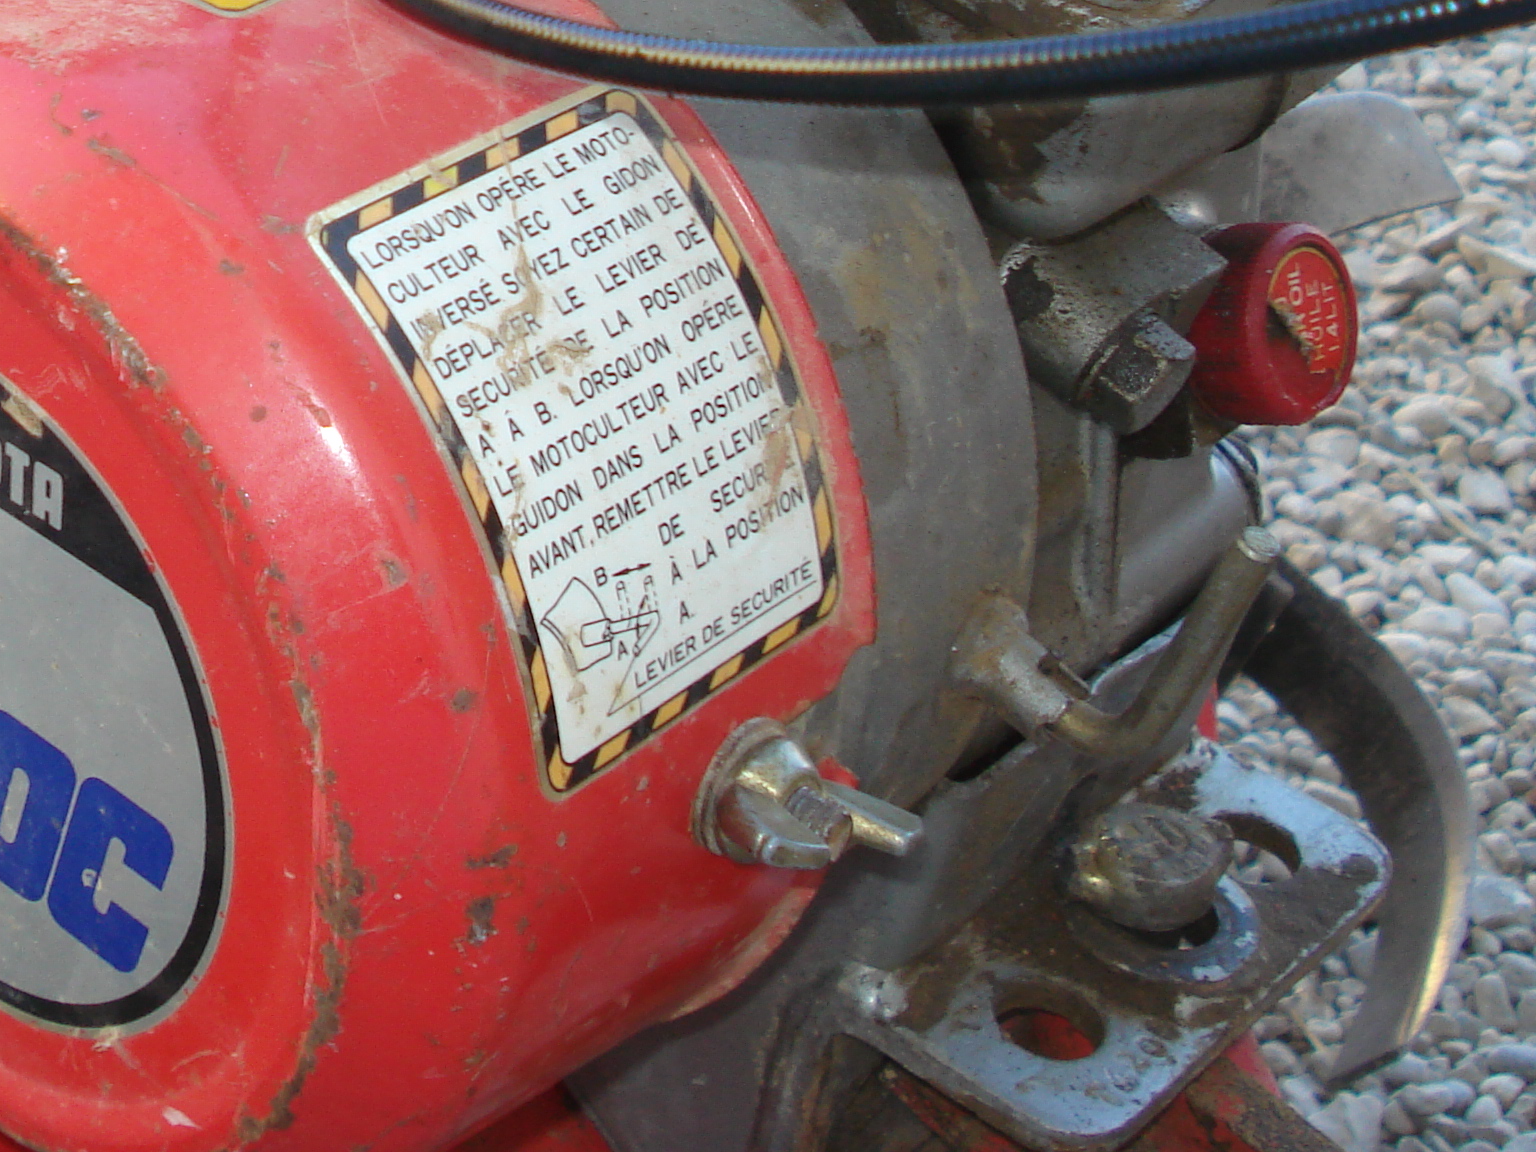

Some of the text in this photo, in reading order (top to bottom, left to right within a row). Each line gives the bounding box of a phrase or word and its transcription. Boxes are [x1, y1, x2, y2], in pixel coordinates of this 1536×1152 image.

[360, 127, 637, 270] LORSQU'ON OPÉRE LE MOTO-
[387, 154, 662, 304] CULTEUR AVEC LE GIDON
[570, 204, 654, 259] CERTAIN
[652, 187, 684, 216] DE
[433, 312, 542, 379] DÉPLAER
[553, 286, 585, 317] LE
[595, 243, 668, 294] LEVIER
[601, 309, 633, 339] LA
[638, 257, 725, 319] POSITION
[1287, 262, 1303, 306] OIL
[478, 434, 496, 459] A
[533, 401, 558, 426] B.
[568, 334, 671, 407] LORSQU'ON
[681, 294, 744, 342] OPÉRE
[494, 331, 760, 498] LE MOTOCULTEUR AVEC LE
[515, 373, 773, 538] GUIDON DANS LA POSITION
[592, 462, 692, 535] REMETTRE
[692, 446, 720, 477] LE
[719, 407, 780, 460] LEVIE
[594, 566, 608, 587] B
[657, 513, 685, 546] DE
[691, 539, 718, 570] LA
[726, 485, 805, 548] POSITION
[617, 640, 629, 661] A
[635, 556, 813, 688] LEVIER DE SECURITÉ
